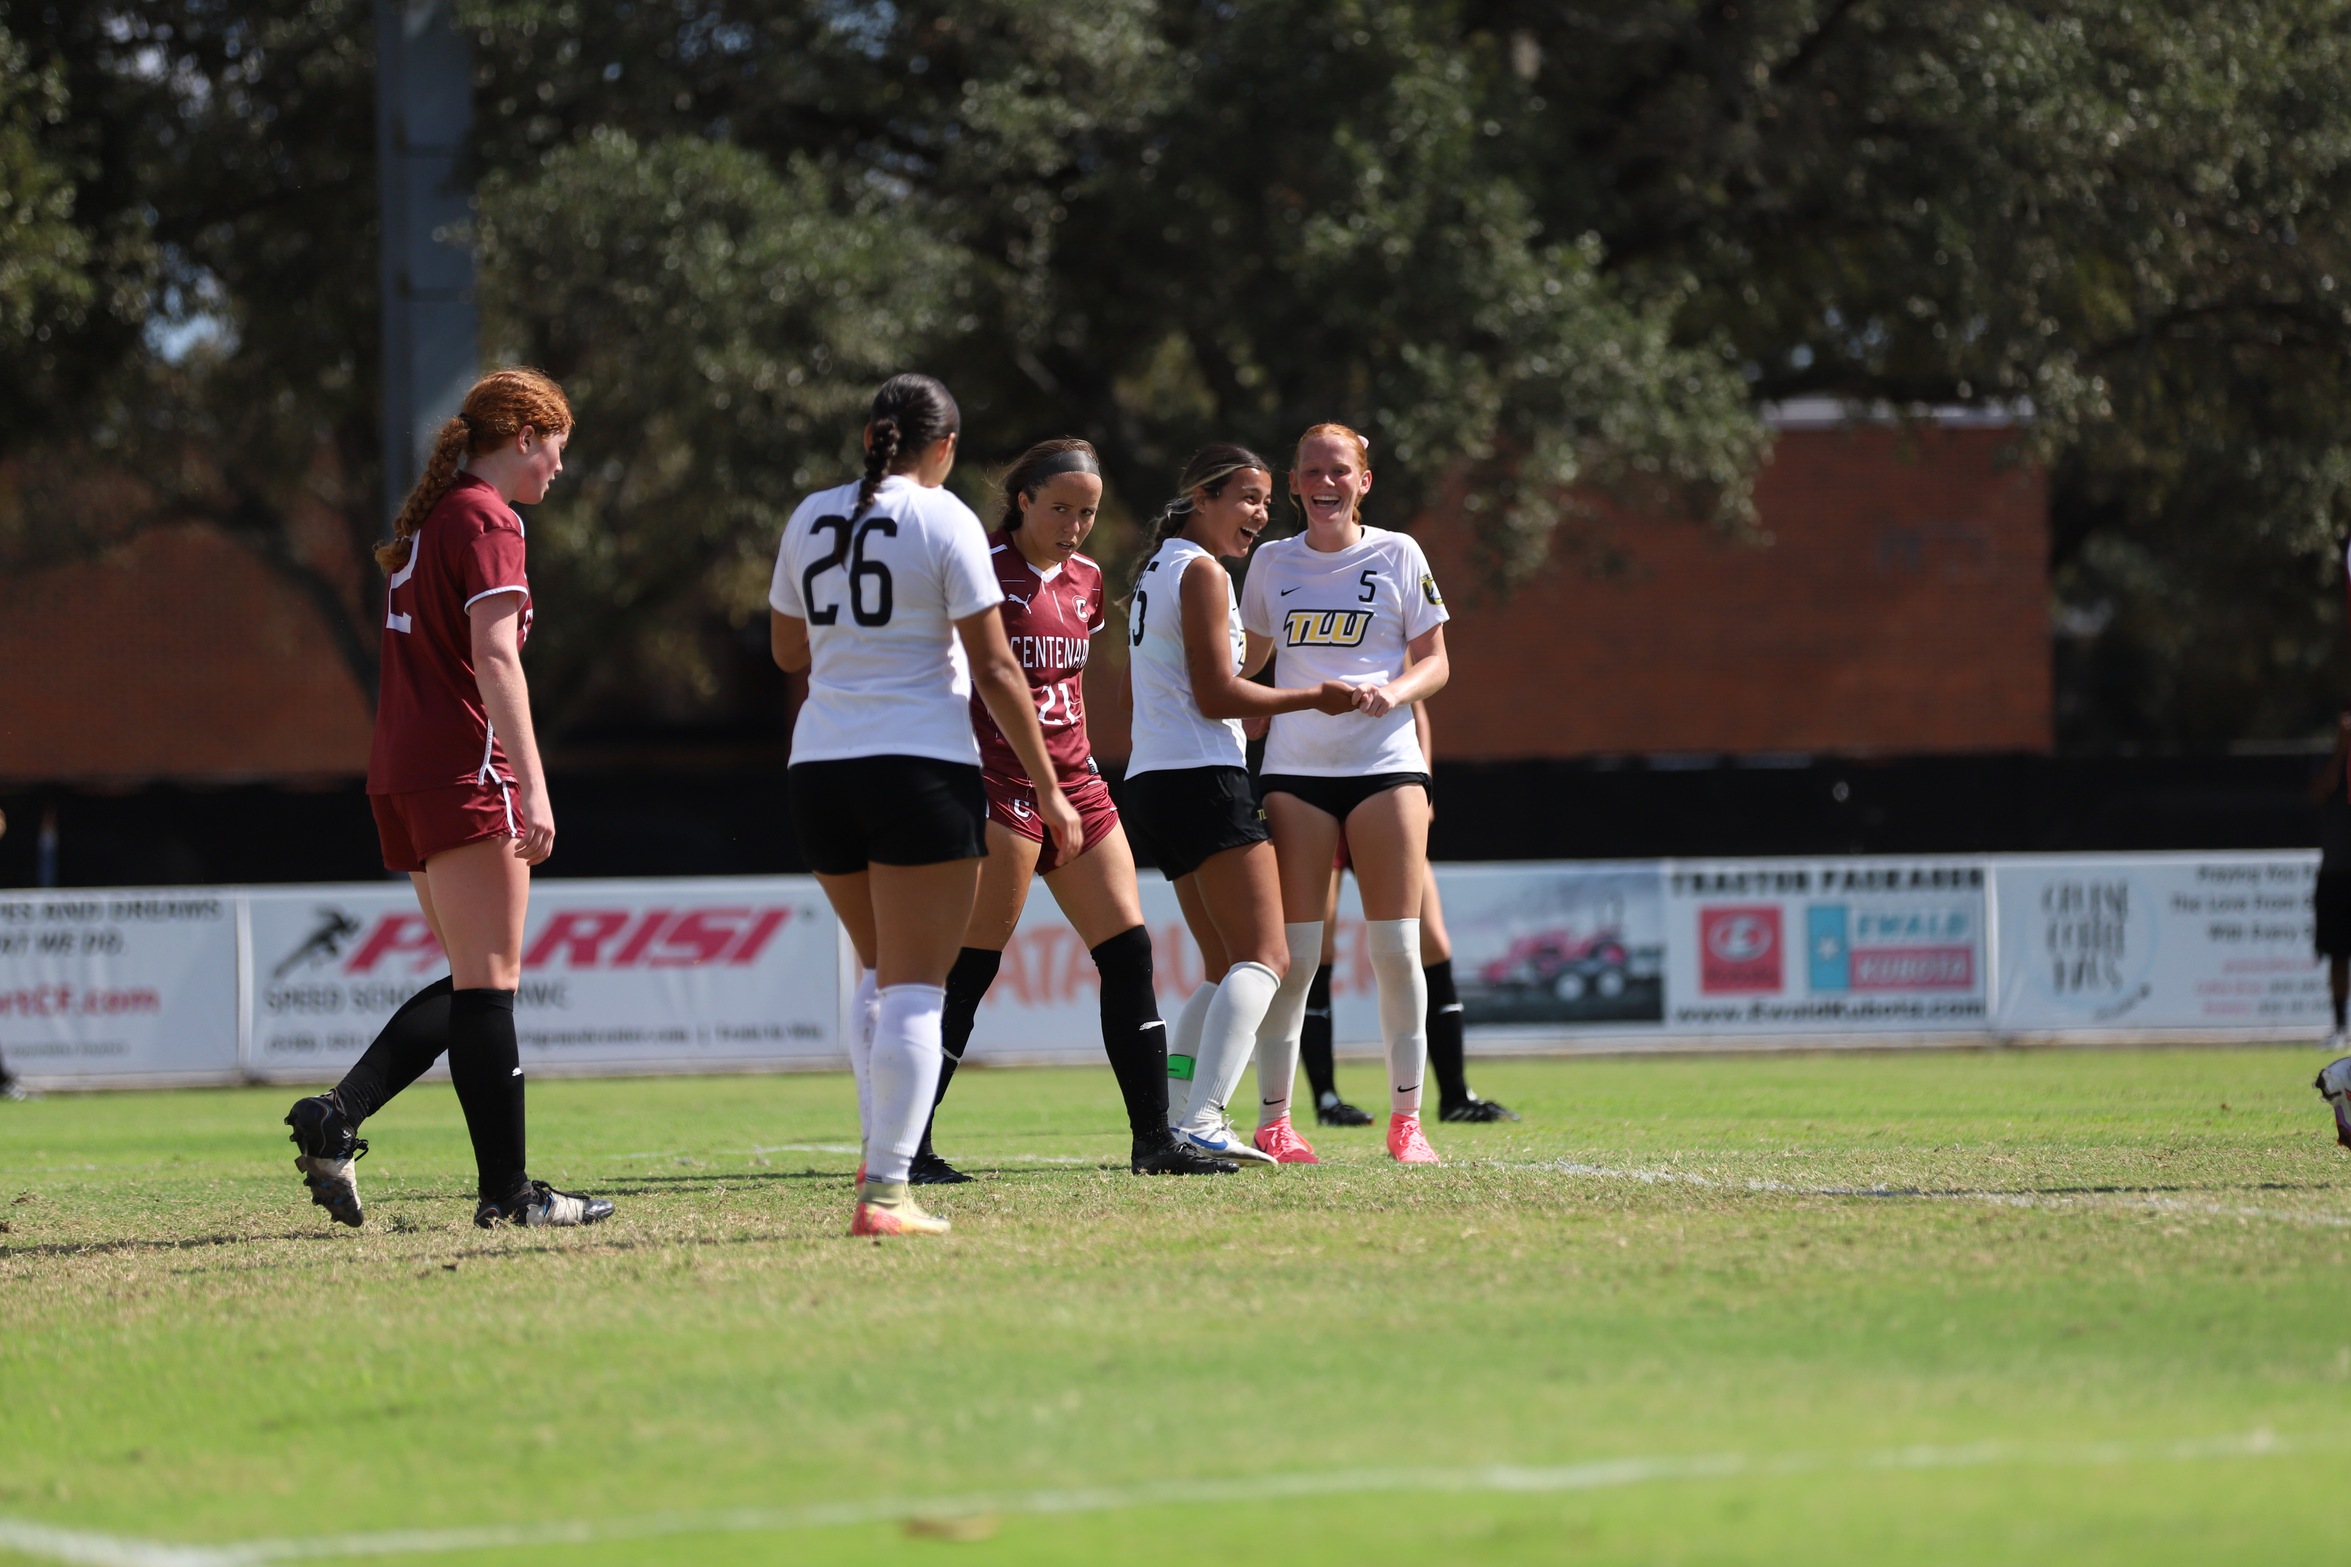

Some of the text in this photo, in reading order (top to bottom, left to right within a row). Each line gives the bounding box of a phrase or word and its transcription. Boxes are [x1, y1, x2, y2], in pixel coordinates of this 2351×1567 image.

[803, 514, 898, 628] 26
[1358, 569, 1378, 603] 5
[1283, 609, 1375, 648] TLU
[1038, 682, 1077, 726] 21
